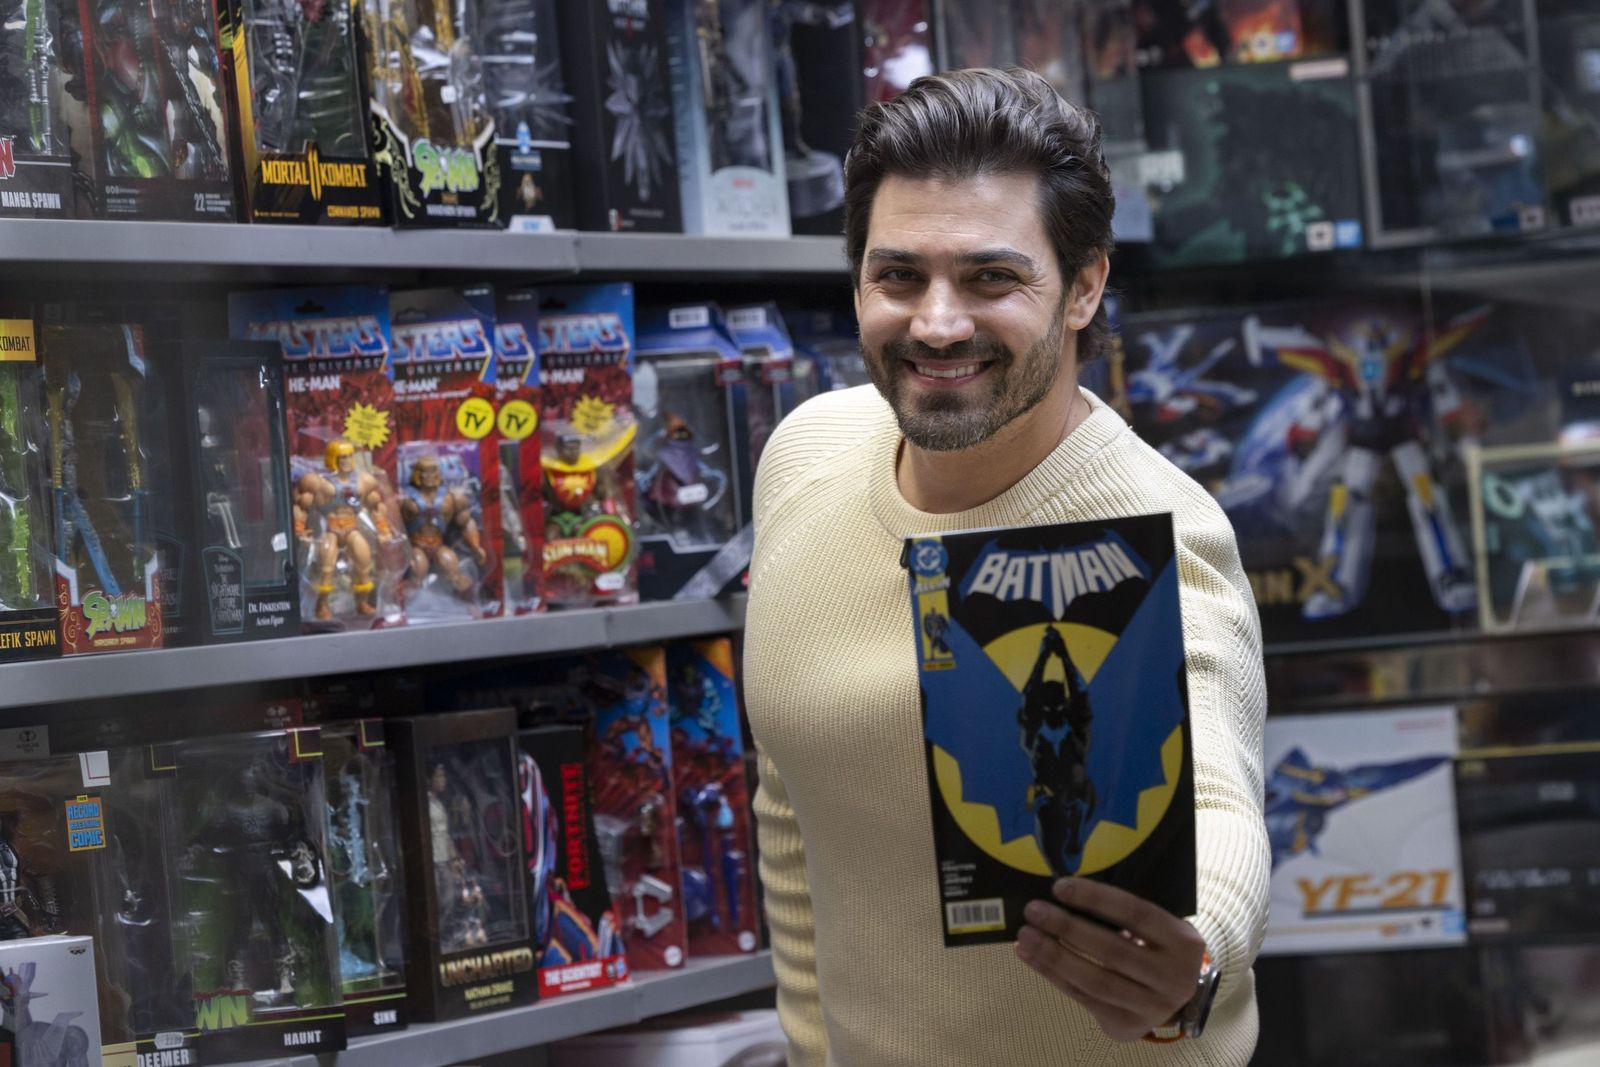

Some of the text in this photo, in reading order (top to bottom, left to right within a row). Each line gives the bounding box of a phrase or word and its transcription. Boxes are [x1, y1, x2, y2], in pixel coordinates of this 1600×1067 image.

[261, 160, 309, 185] MORTAL
[319, 162, 367, 187] KOMBAT
[1, 191, 61, 209] MANGA SPAWN
[465, 410, 487, 431] TV
[506, 412, 529, 433] TV
[966, 541, 1146, 622] BATMAN
[81, 589, 147, 640] SPAWN
[25, 630, 56, 646] SPAWN
[67, 803, 99, 819] RECORD
[70, 829, 103, 848] COMIC
[1296, 869, 1452, 914] YF-21
[439, 946, 533, 987] UNCHARTED
[544, 970, 561, 987] THE
[374, 1010, 397, 1025] SINN
[283, 1030, 321, 1046] HAUNT
